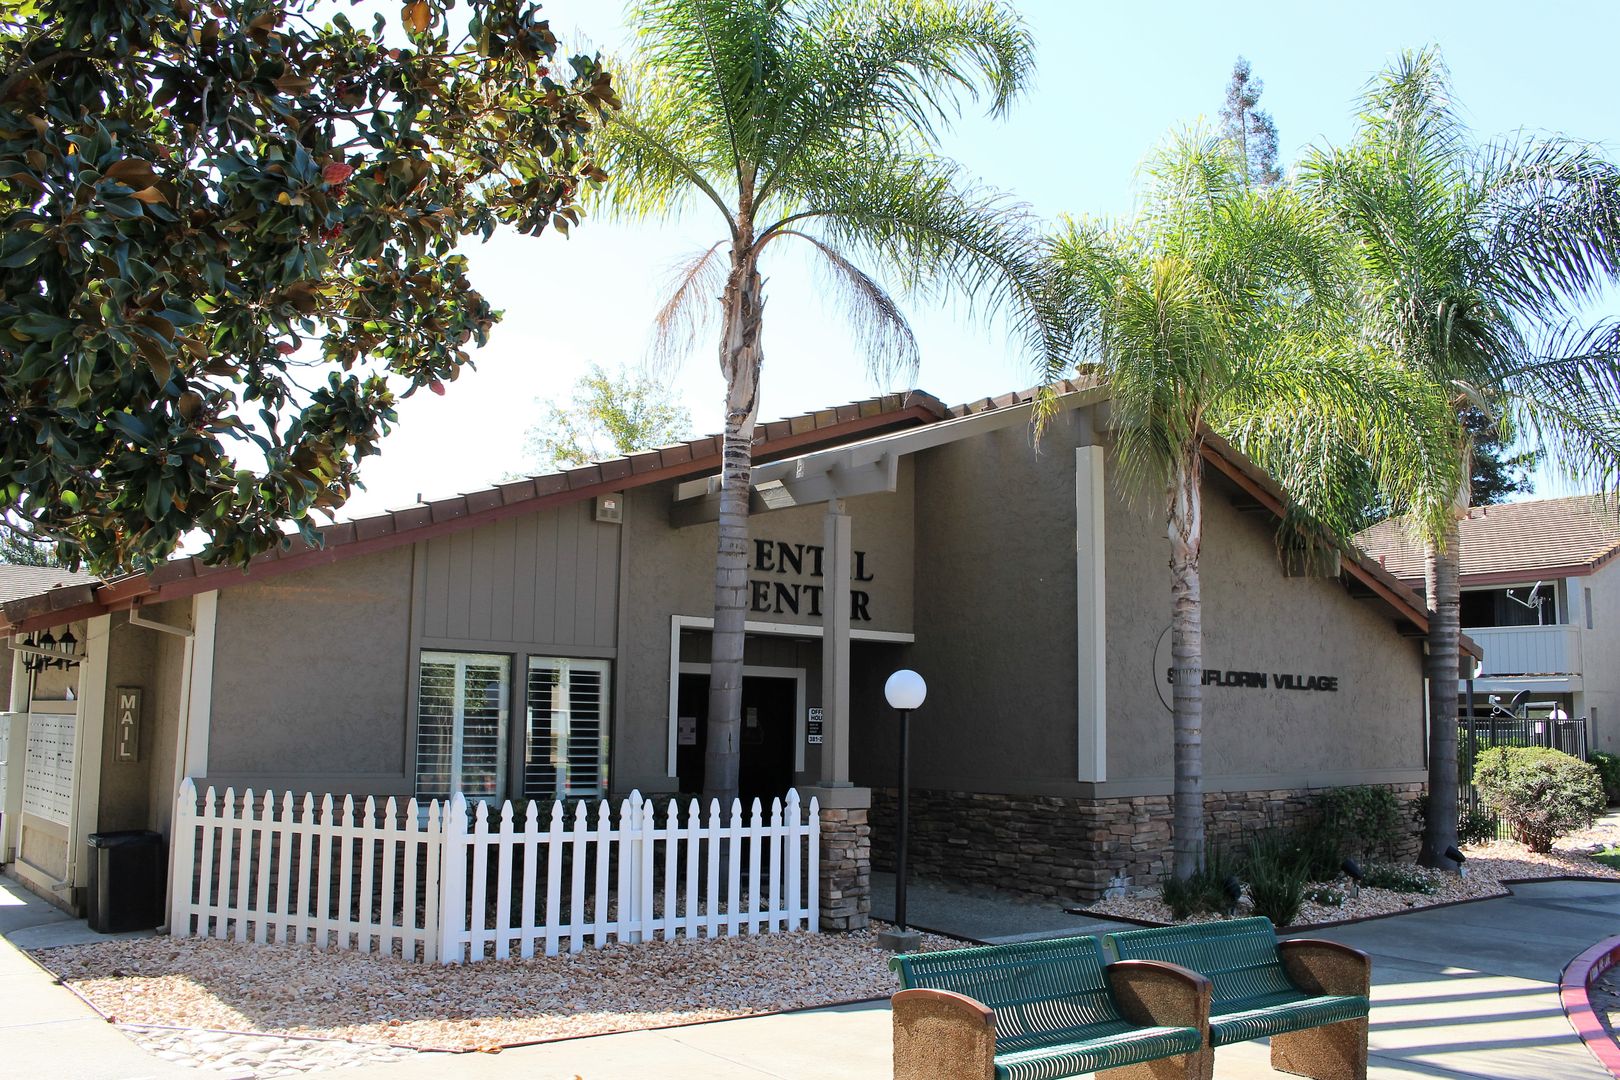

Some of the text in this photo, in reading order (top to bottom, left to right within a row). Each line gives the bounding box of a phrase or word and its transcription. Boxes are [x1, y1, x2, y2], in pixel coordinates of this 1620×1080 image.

[747, 539, 874, 581] ENTL
[745, 580, 872, 621] ENTR
[1167, 667, 1338, 691] SNFLORIN VILLAGE
[120, 695, 135, 756] MAIL
